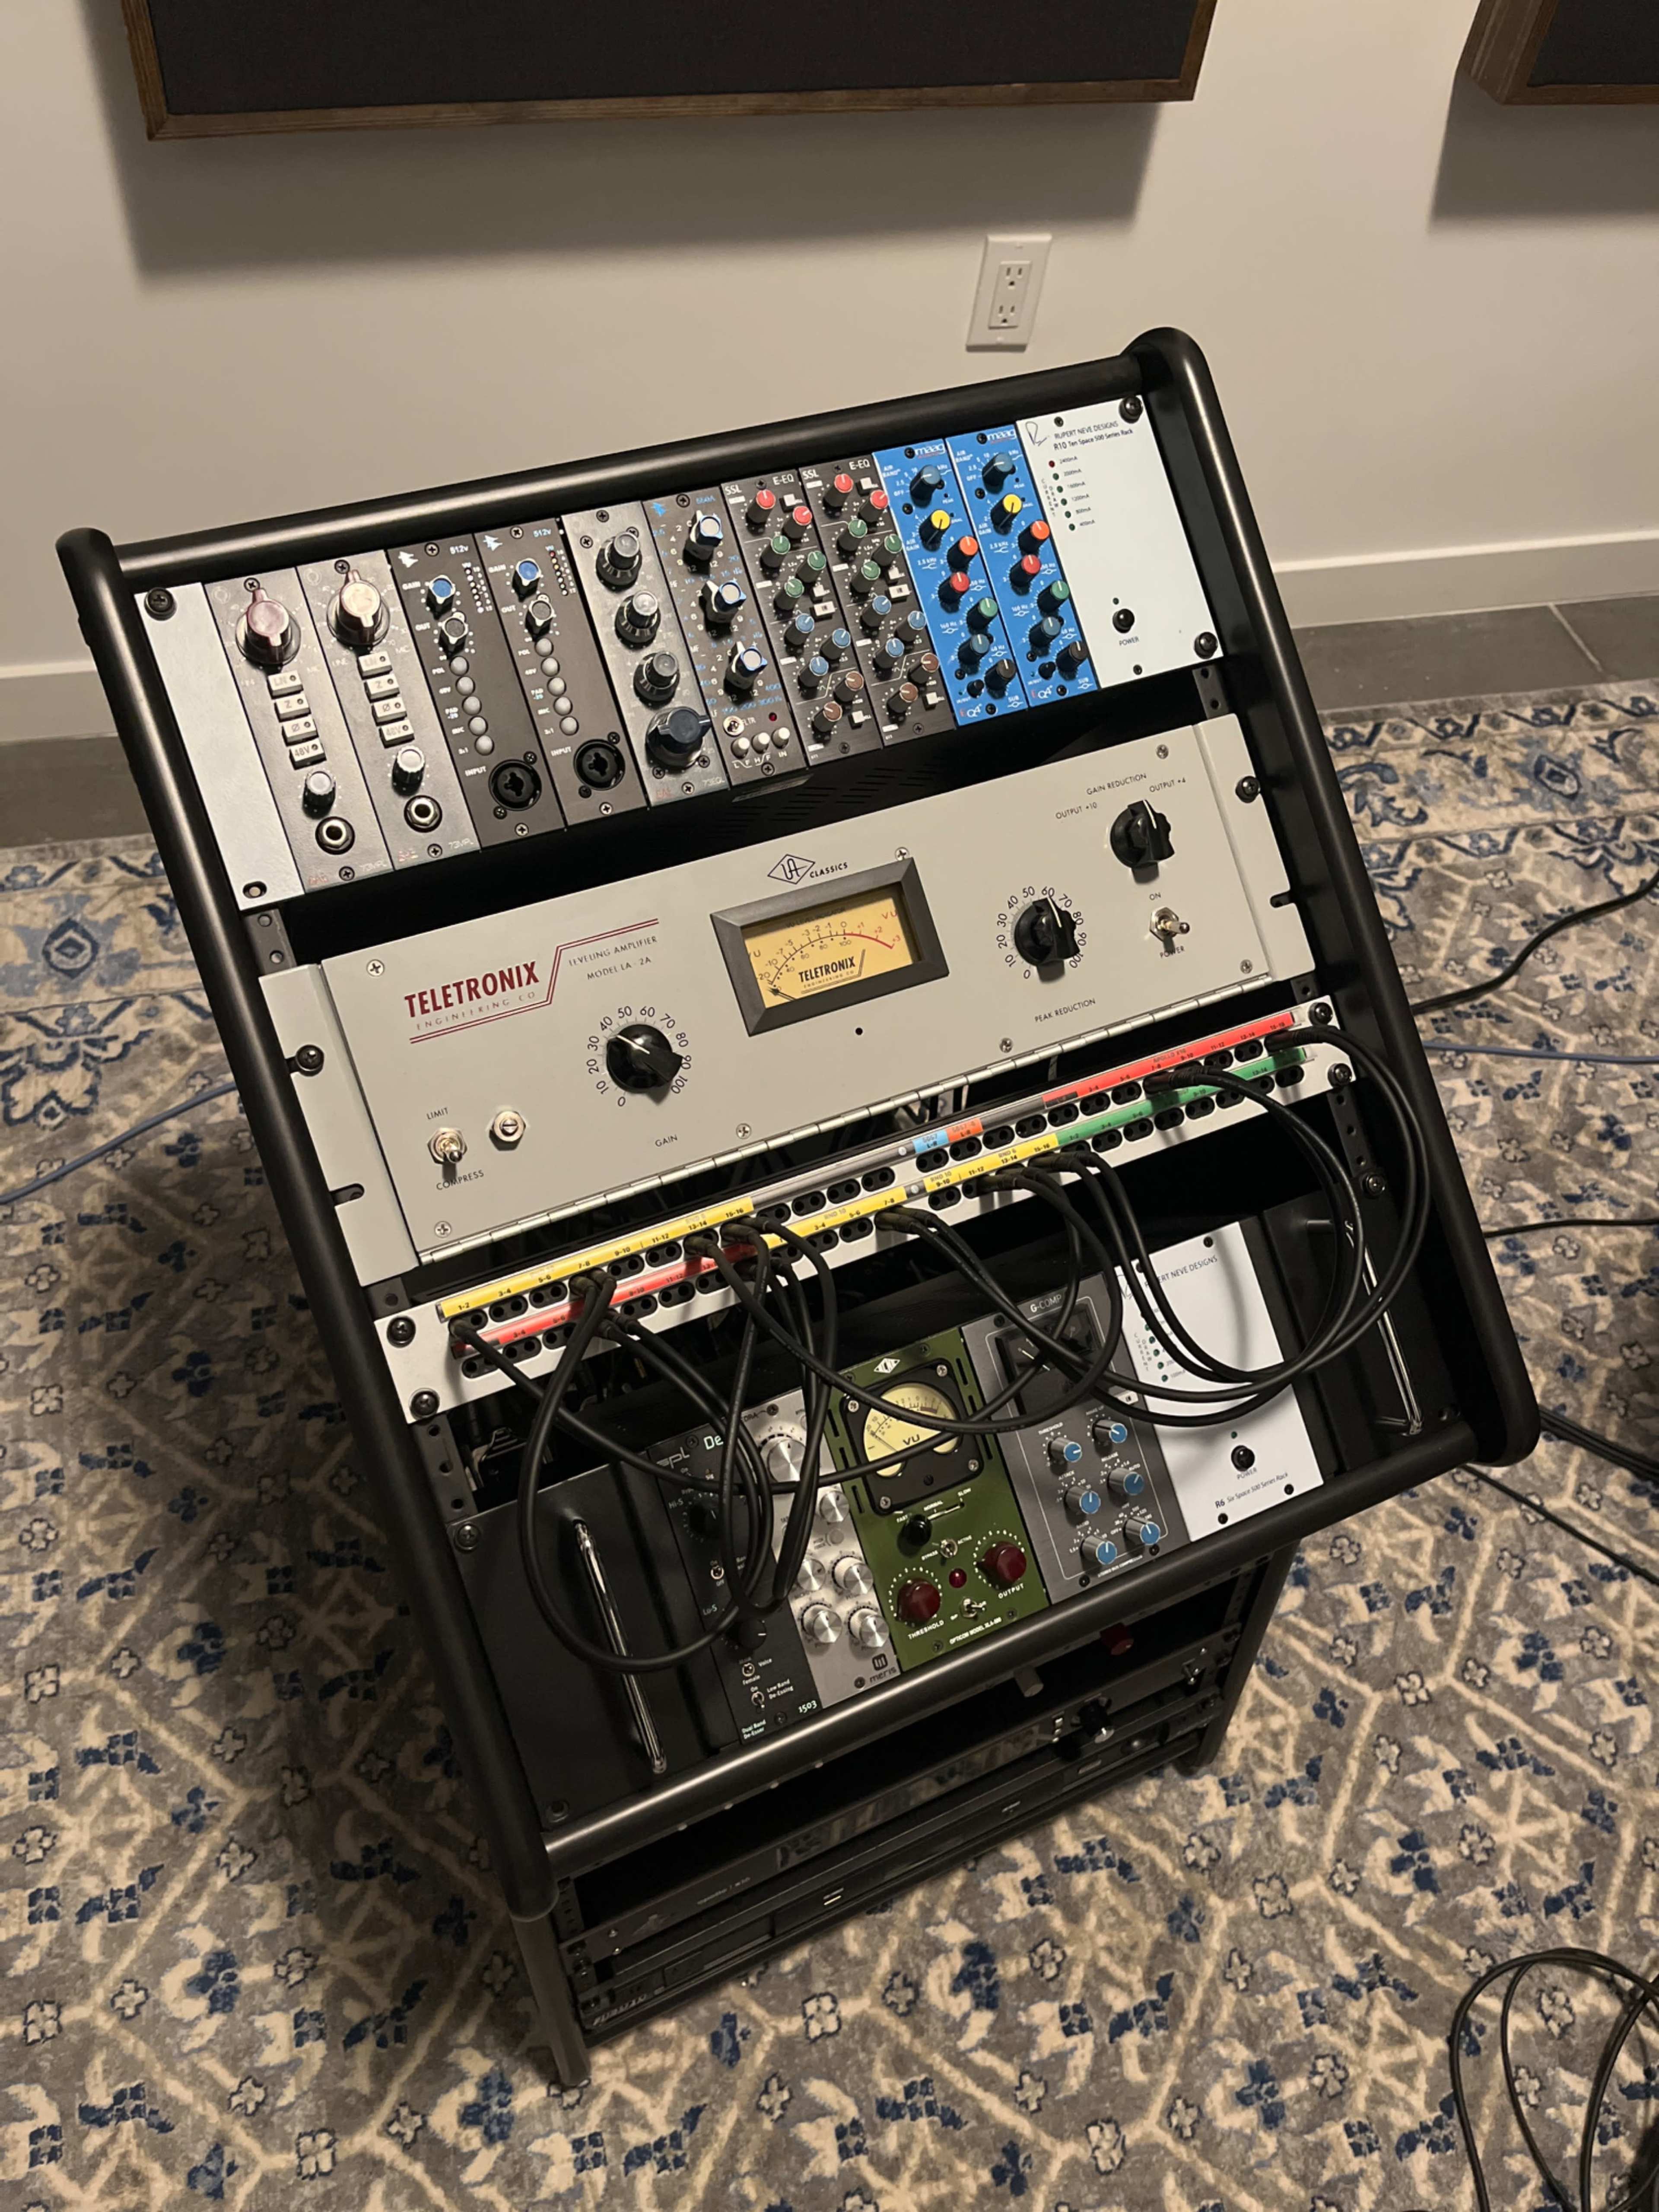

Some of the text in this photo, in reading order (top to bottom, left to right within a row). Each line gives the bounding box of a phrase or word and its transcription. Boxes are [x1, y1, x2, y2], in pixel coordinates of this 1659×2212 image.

[987, 429, 1016, 442] maag
[1054, 421, 1119, 439] RUPERT NEVE DESIGNS
[915, 443, 946, 457] maag
[1054, 442, 1067, 450] R10
[1078, 437, 1094, 445] Space
[849, 460, 870, 470] E-EQ
[773, 474, 794, 486] E-EQ
[802, 470, 819, 480] SSL
[725, 486, 742, 496] SSL
[450, 545, 469, 555] 512v
[489, 564, 506, 573] GAIN
[402, 582, 421, 590] GAIN
[501, 605, 516, 613] OUT
[415, 622, 431, 631] OUT
[1119, 636, 1139, 646] POWER
[294, 746, 311, 758] 48V
[551, 746, 572, 757] INPUT
[465, 766, 487, 777] INPUT
[1086, 773, 1147, 795] GAIN REDUCTION
[1149, 779, 1175, 793] OUTPUT
[1055, 802, 1098, 819] OUTPUT +10
[809, 862, 849, 879] CLASSICS
[1022, 886, 1035, 898] 50
[1041, 886, 1055, 898] 60
[1149, 892, 1162, 901] ON
[1007, 895, 1018, 909] 40
[1058, 893, 1072, 908] 70
[997, 913, 1007, 928] 30
[1073, 911, 1084, 925] 80
[801, 929, 810, 938] -3
[812, 925, 821, 933] -2
[996, 934, 1008, 949] 20
[1077, 932, 1087, 947] 90
[568, 935, 658, 967] LEVELING AMPLIFIER
[1159, 945, 1186, 959] POWER
[765, 958, 779, 967] -10
[1004, 954, 1016, 968] 10
[587, 965, 619, 980] MODEL
[798, 956, 856, 983] TELETRONIX
[1023, 969, 1031, 979] 0
[404, 960, 540, 1018] TELETRONIX
[416, 998, 510, 1031] ENGINEERING
[617, 1006, 632, 1019] 50
[639, 1005, 655, 1017] 60
[1034, 998, 1096, 1024] PEAK REDUCTION
[600, 1016, 613, 1031] 40
[660, 1013, 676, 1029] 70
[587, 1036, 600, 1051] 30
[675, 1032, 689, 1047] 80
[586, 1058, 600, 1074] 20
[680, 1055, 692, 1070] 90
[596, 1080, 609, 1095] 10
[670, 1075, 688, 1094] 100
[617, 1096, 626, 1107] 0
[426, 1107, 449, 1120] LIMIT
[654, 1134, 678, 1147] GAIN
[936, 1143, 1051, 1188] 9-10 11-12 13-14 15-16
[436, 1169, 485, 1191] COMPRESS
[930, 1173, 944, 1183] RND
[814, 1222, 826, 1231] 3-4
[849, 1210, 861, 1218] 5-6
[458, 1208, 744, 1311] 1-2 3-4 5-6 7-8 9-10 11-12 13-14 15-16
[1170, 1265, 1189, 1280] NEVE
[1189, 1255, 1218, 1271] DESIGNS
[513, 1273, 684, 1339] 3-4 5-6 9-10 11-12
[1030, 1294, 1062, 1313] G-COMP
[903, 1433, 921, 1446] VU
[1058, 1470, 1075, 1481] ATTACK
[1237, 1467, 1257, 1480] POWER
[1214, 1499, 1225, 1509] R6
[1235, 1489, 1250, 1500] Space
[1251, 1483, 1261, 1493] 500
[1261, 1479, 1276, 1488] Series
[1275, 1472, 1288, 1481] Rack
[923, 1500, 944, 1512] NORMAL
[896, 1515, 908, 1523] FAST
[957, 1535, 972, 1545] ACTIVE
[998, 1583, 1024, 1599] OUTPUT
[908, 1620, 945, 1640] THRESHOLD
[758, 1658, 772, 1668] Voice
[742, 1675, 761, 1686] Female
[869, 1665, 898, 1684] meris
[766, 1678, 791, 1694] Low Band
[768, 1686, 794, 1700] De-Essing
[798, 1700, 817, 1714] 1503
[741, 1719, 767, 1734] Dual Band
[743, 1727, 765, 1740] De-Esser
